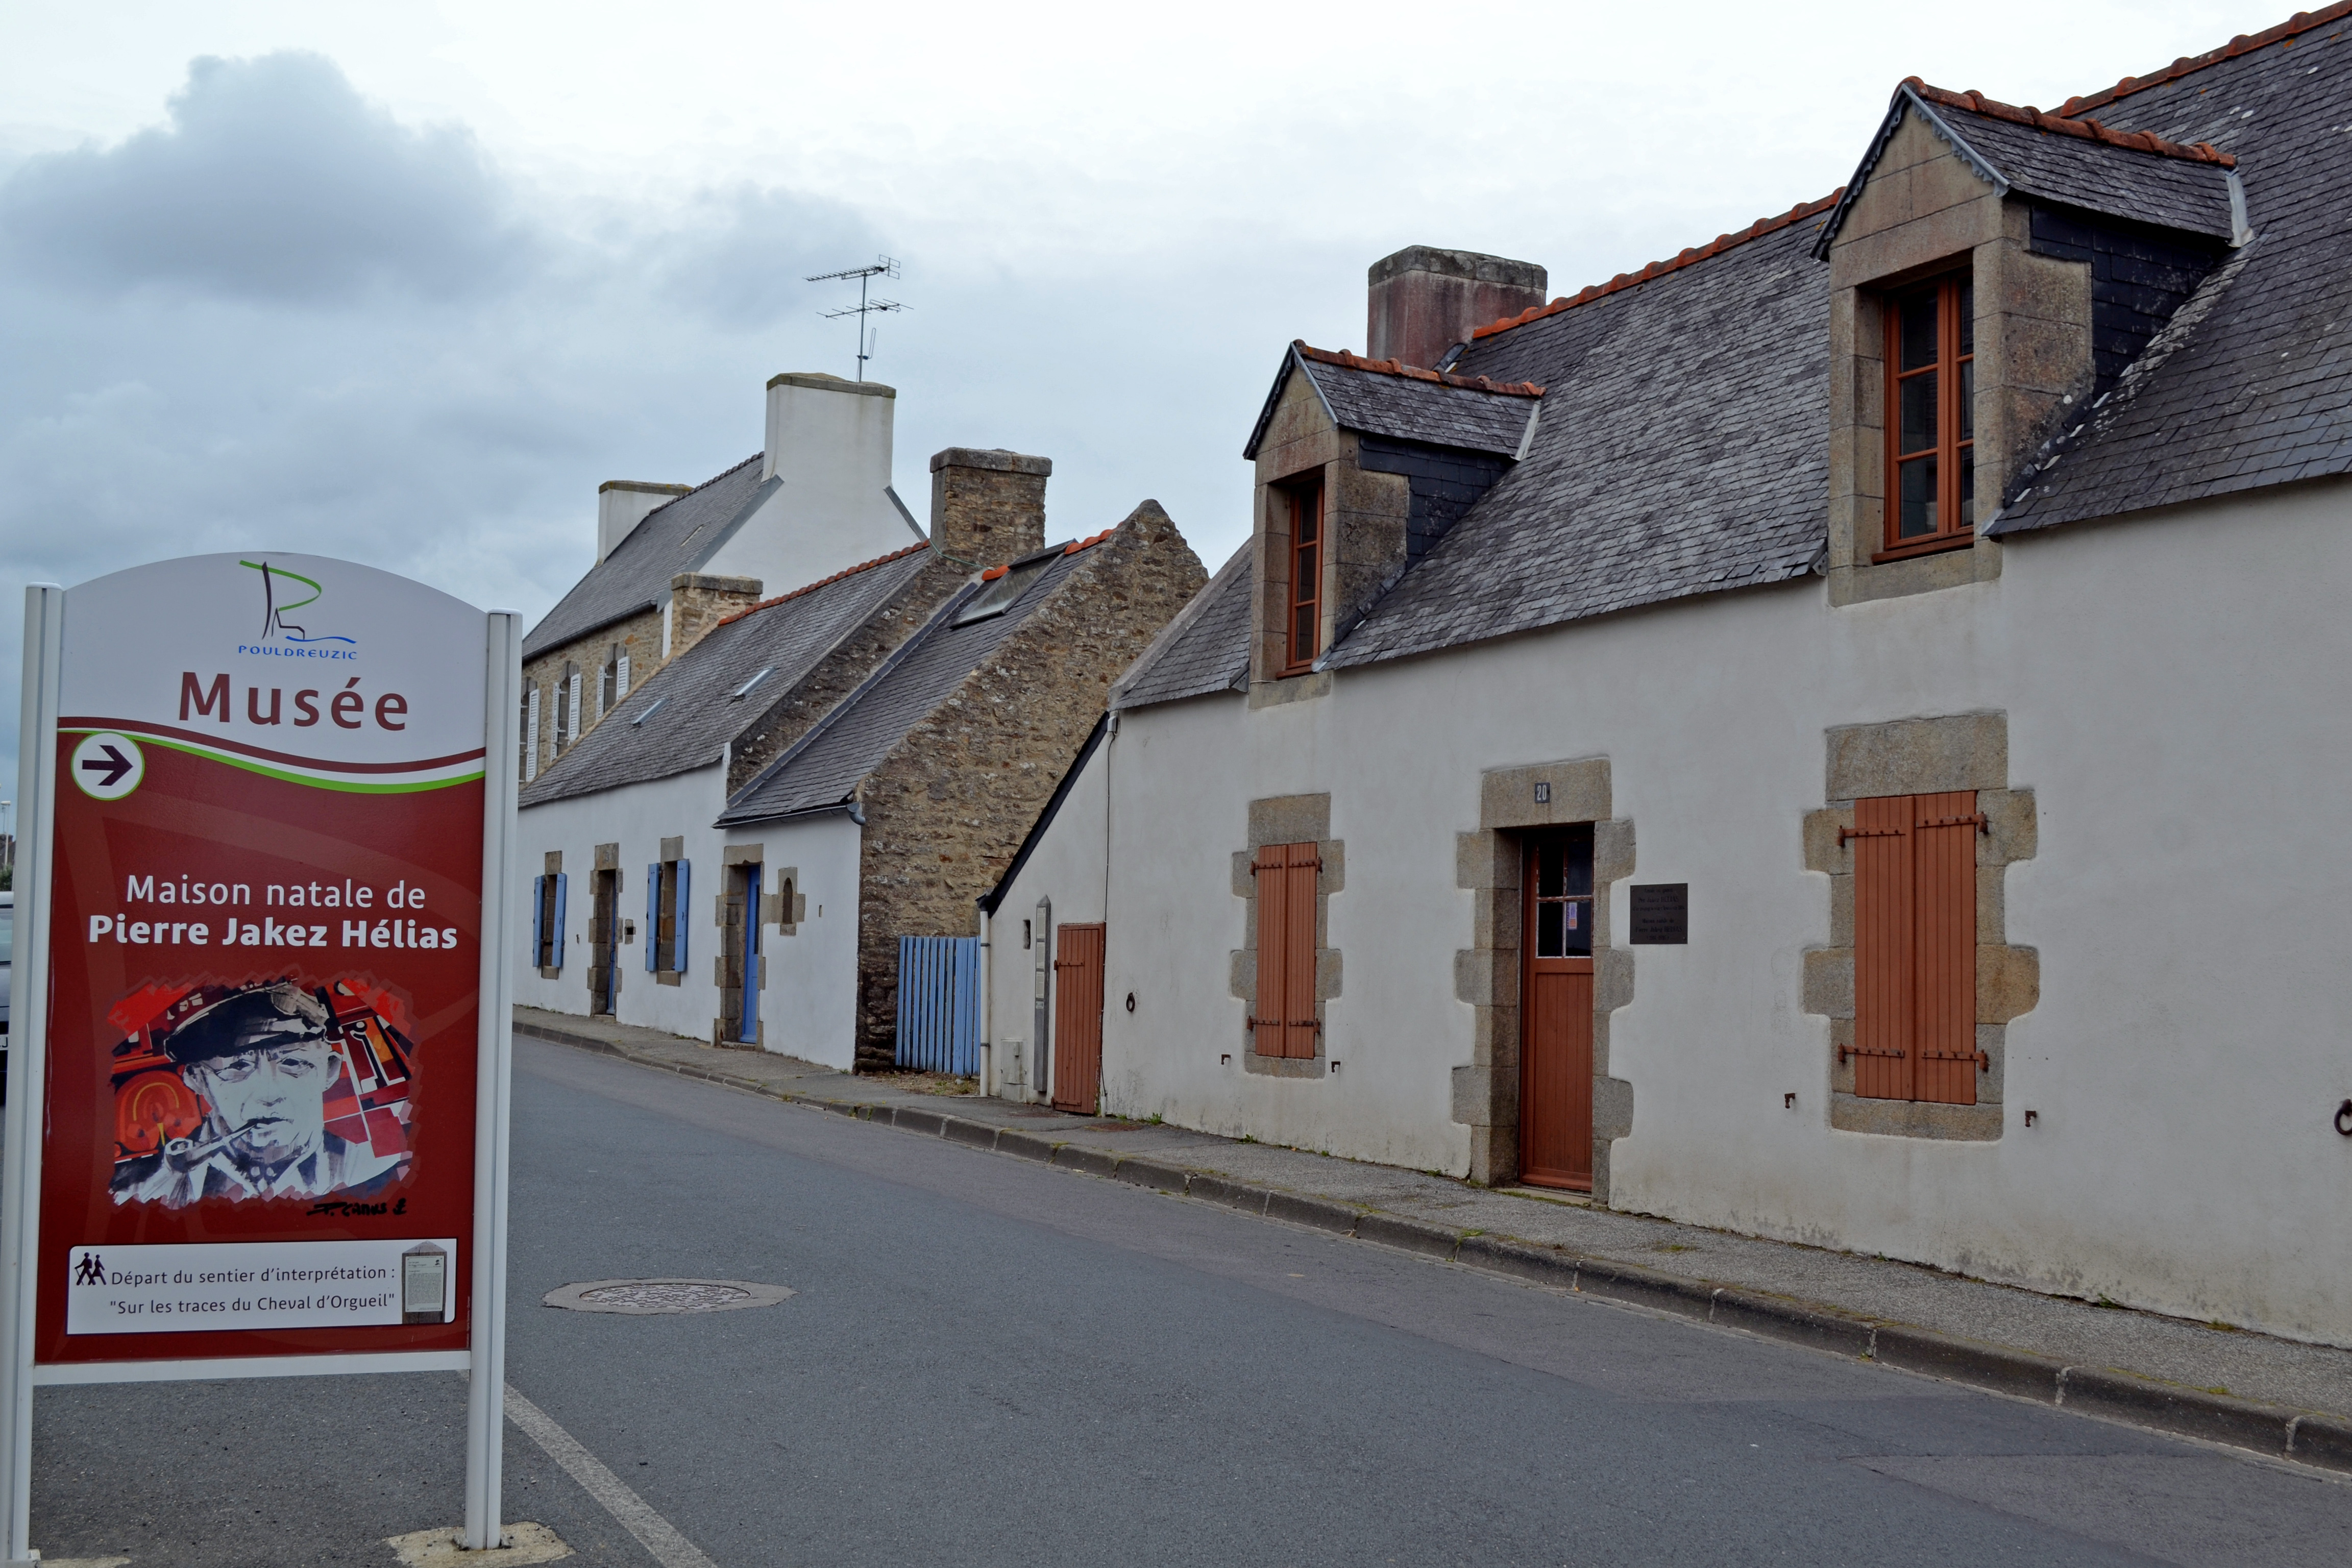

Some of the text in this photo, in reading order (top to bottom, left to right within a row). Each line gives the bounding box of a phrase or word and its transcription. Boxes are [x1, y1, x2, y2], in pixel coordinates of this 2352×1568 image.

[238, 645, 357, 660] POULDREUZIC
[179, 671, 408, 731] Musée
[1537, 784, 1547, 801] 20
[127, 874, 426, 910] Maison natale de
[89, 913, 458, 949] Pierre Jakez Hélias
[111, 1271, 168, 1288] Départ
[173, 1269, 193, 1284] du
[199, 1267, 256, 1284] sentier
[150, 1298, 173, 1314] les
[177, 1300, 226, 1313] traces
[231, 1296, 251, 1312] du
[257, 1294, 311, 1311] Cheval
